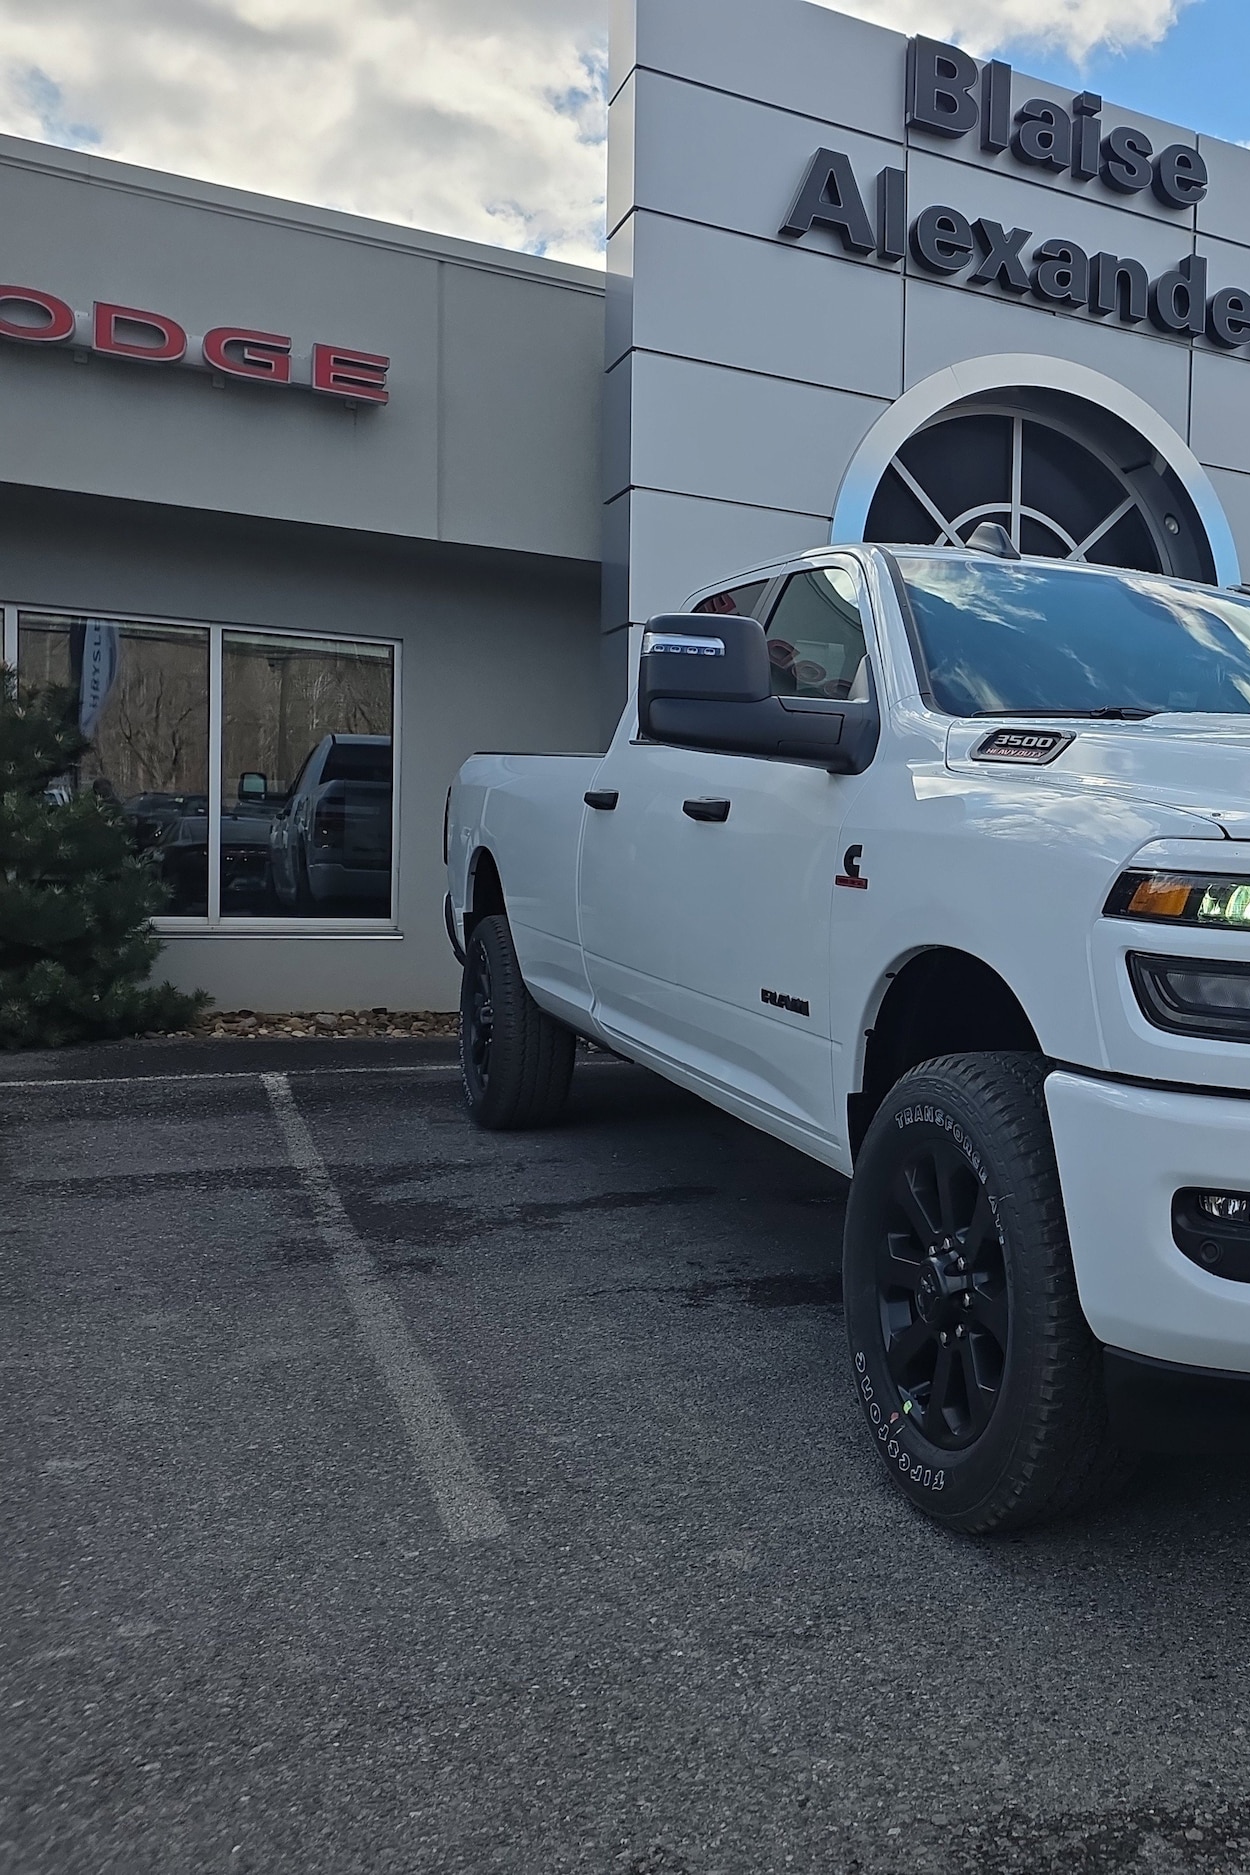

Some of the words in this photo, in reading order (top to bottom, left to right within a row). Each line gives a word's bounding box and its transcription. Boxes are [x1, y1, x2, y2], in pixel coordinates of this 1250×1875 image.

[905, 33, 1209, 210] Blaise
[995, 735, 1053, 747] 3500
[761, 988, 810, 1017] RAM
[894, 1104, 988, 1185] TRANSFORCE
[855, 1347, 945, 1490] Firestone
